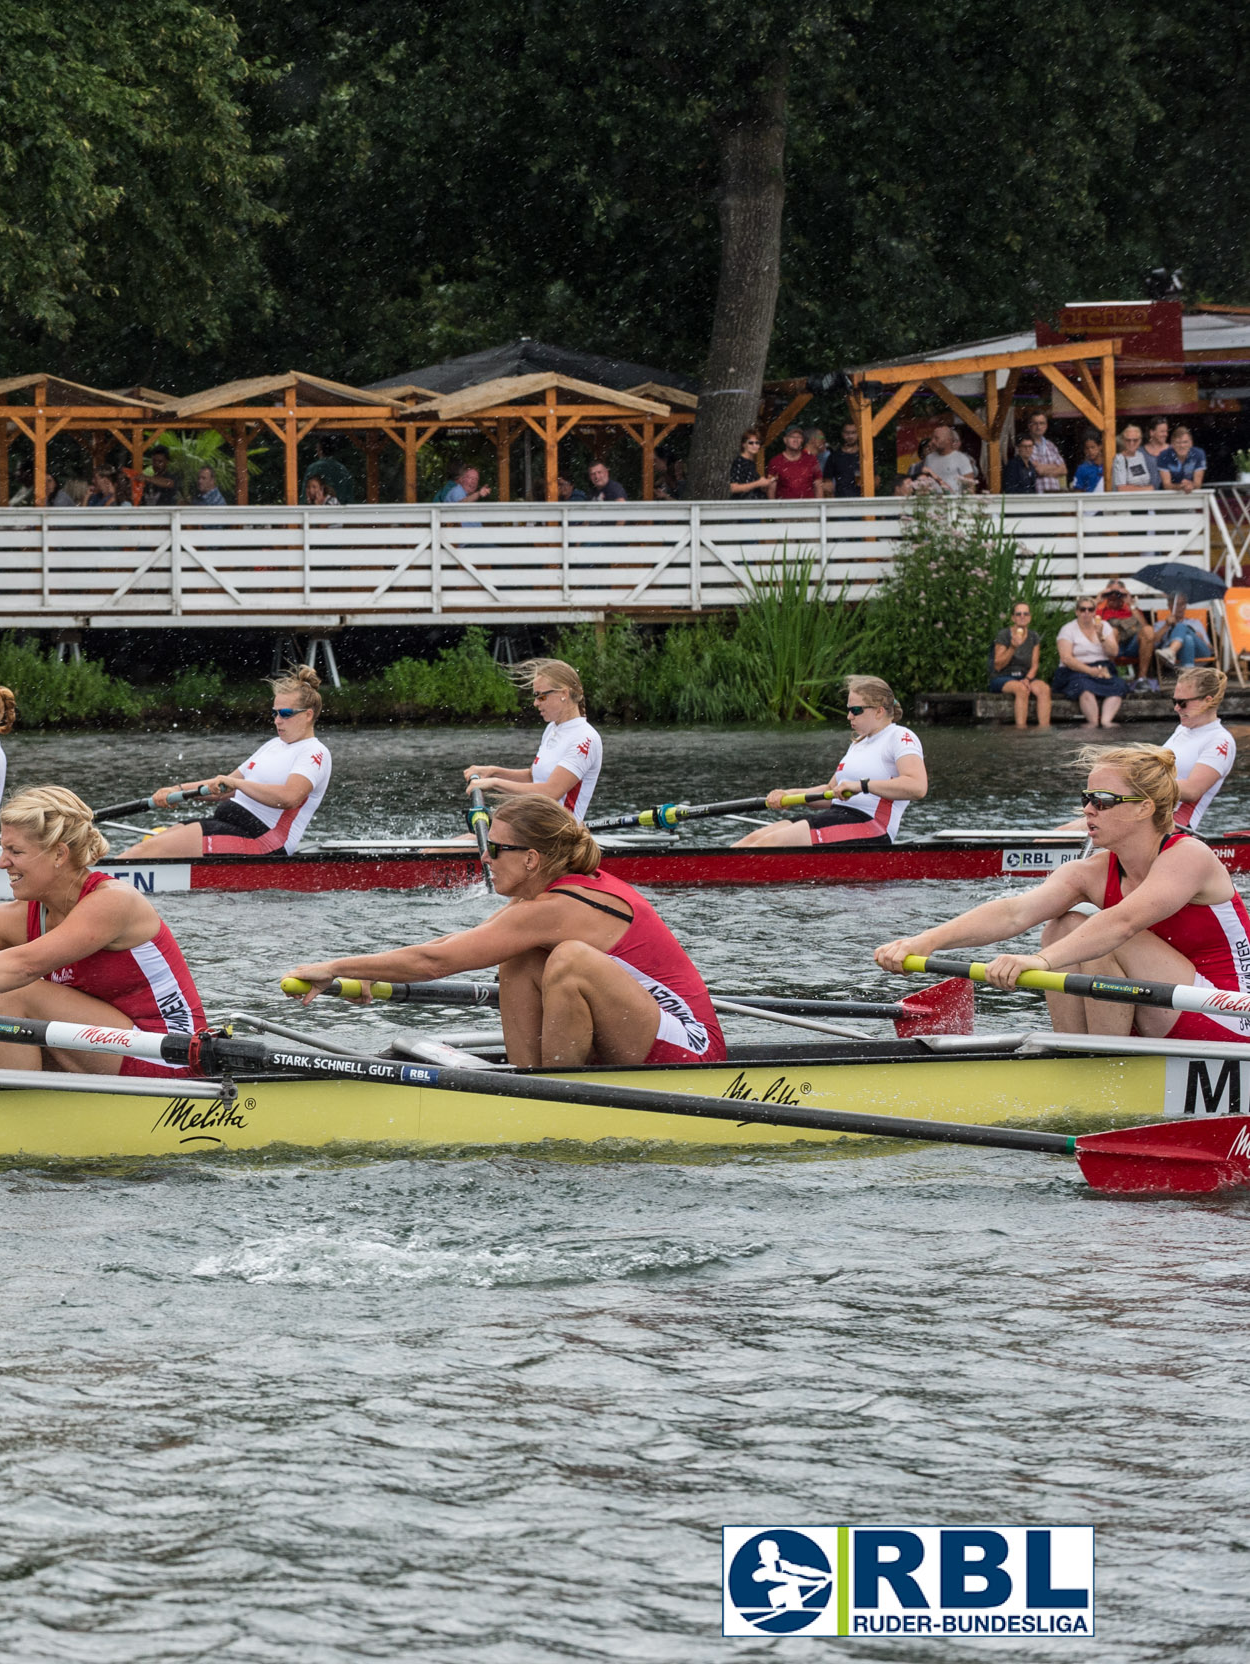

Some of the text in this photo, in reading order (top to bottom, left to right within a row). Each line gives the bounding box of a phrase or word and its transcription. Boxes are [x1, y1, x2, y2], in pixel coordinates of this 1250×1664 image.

[1022, 853, 1053, 864] RBL
[73, 1025, 133, 1049] Melitta
[273, 1053, 395, 1078] STARK. SCHNELL. GUT.
[409, 1069, 431, 1080] RBL
[150, 1097, 250, 1133] Melitta
